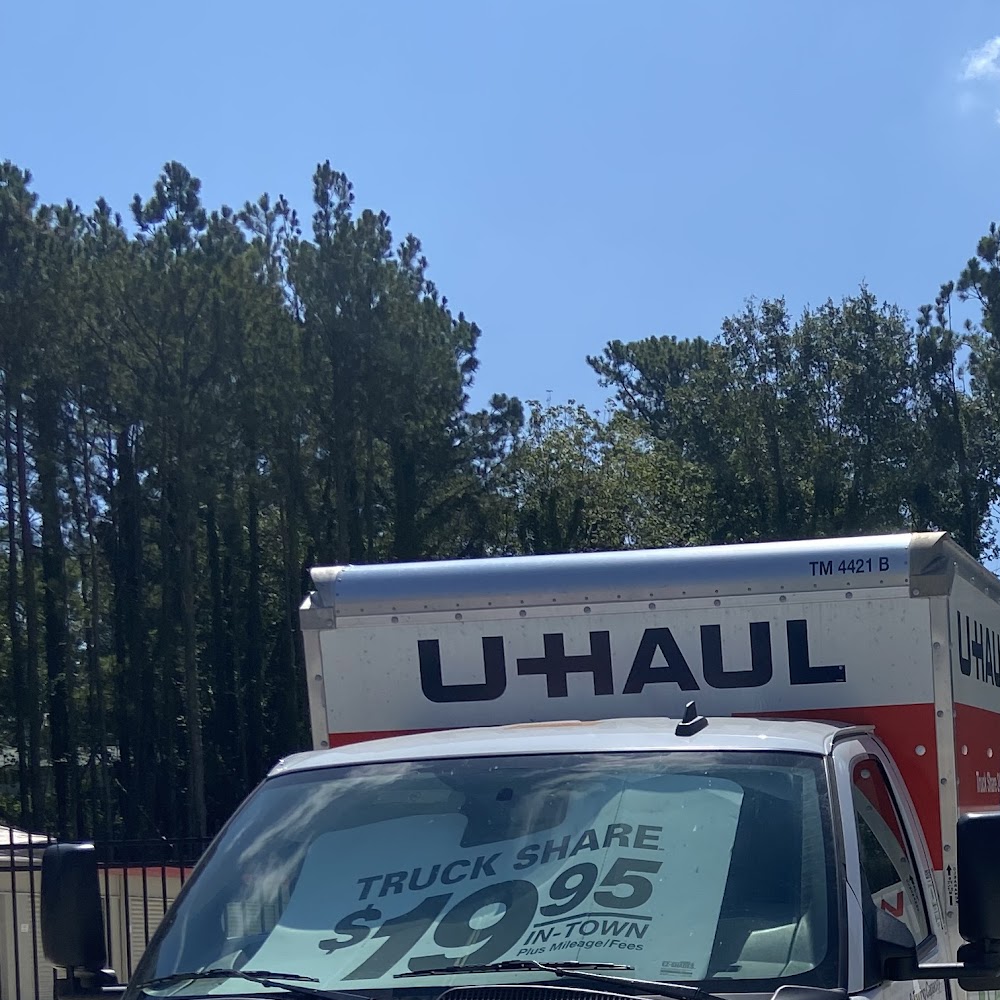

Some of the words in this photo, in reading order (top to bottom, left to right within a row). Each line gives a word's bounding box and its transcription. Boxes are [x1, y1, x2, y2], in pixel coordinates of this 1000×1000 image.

[809, 560, 833, 576] TM
[838, 557, 872, 574] 4421
[879, 556, 890, 572] B
[357, 852, 503, 901] TRUCK
[512, 823, 664, 870] SHARE
[523, 920, 650, 946] IN-TOWN
[516, 946, 546, 957] Plus
[549, 939, 644, 952] Mileage/Fees
